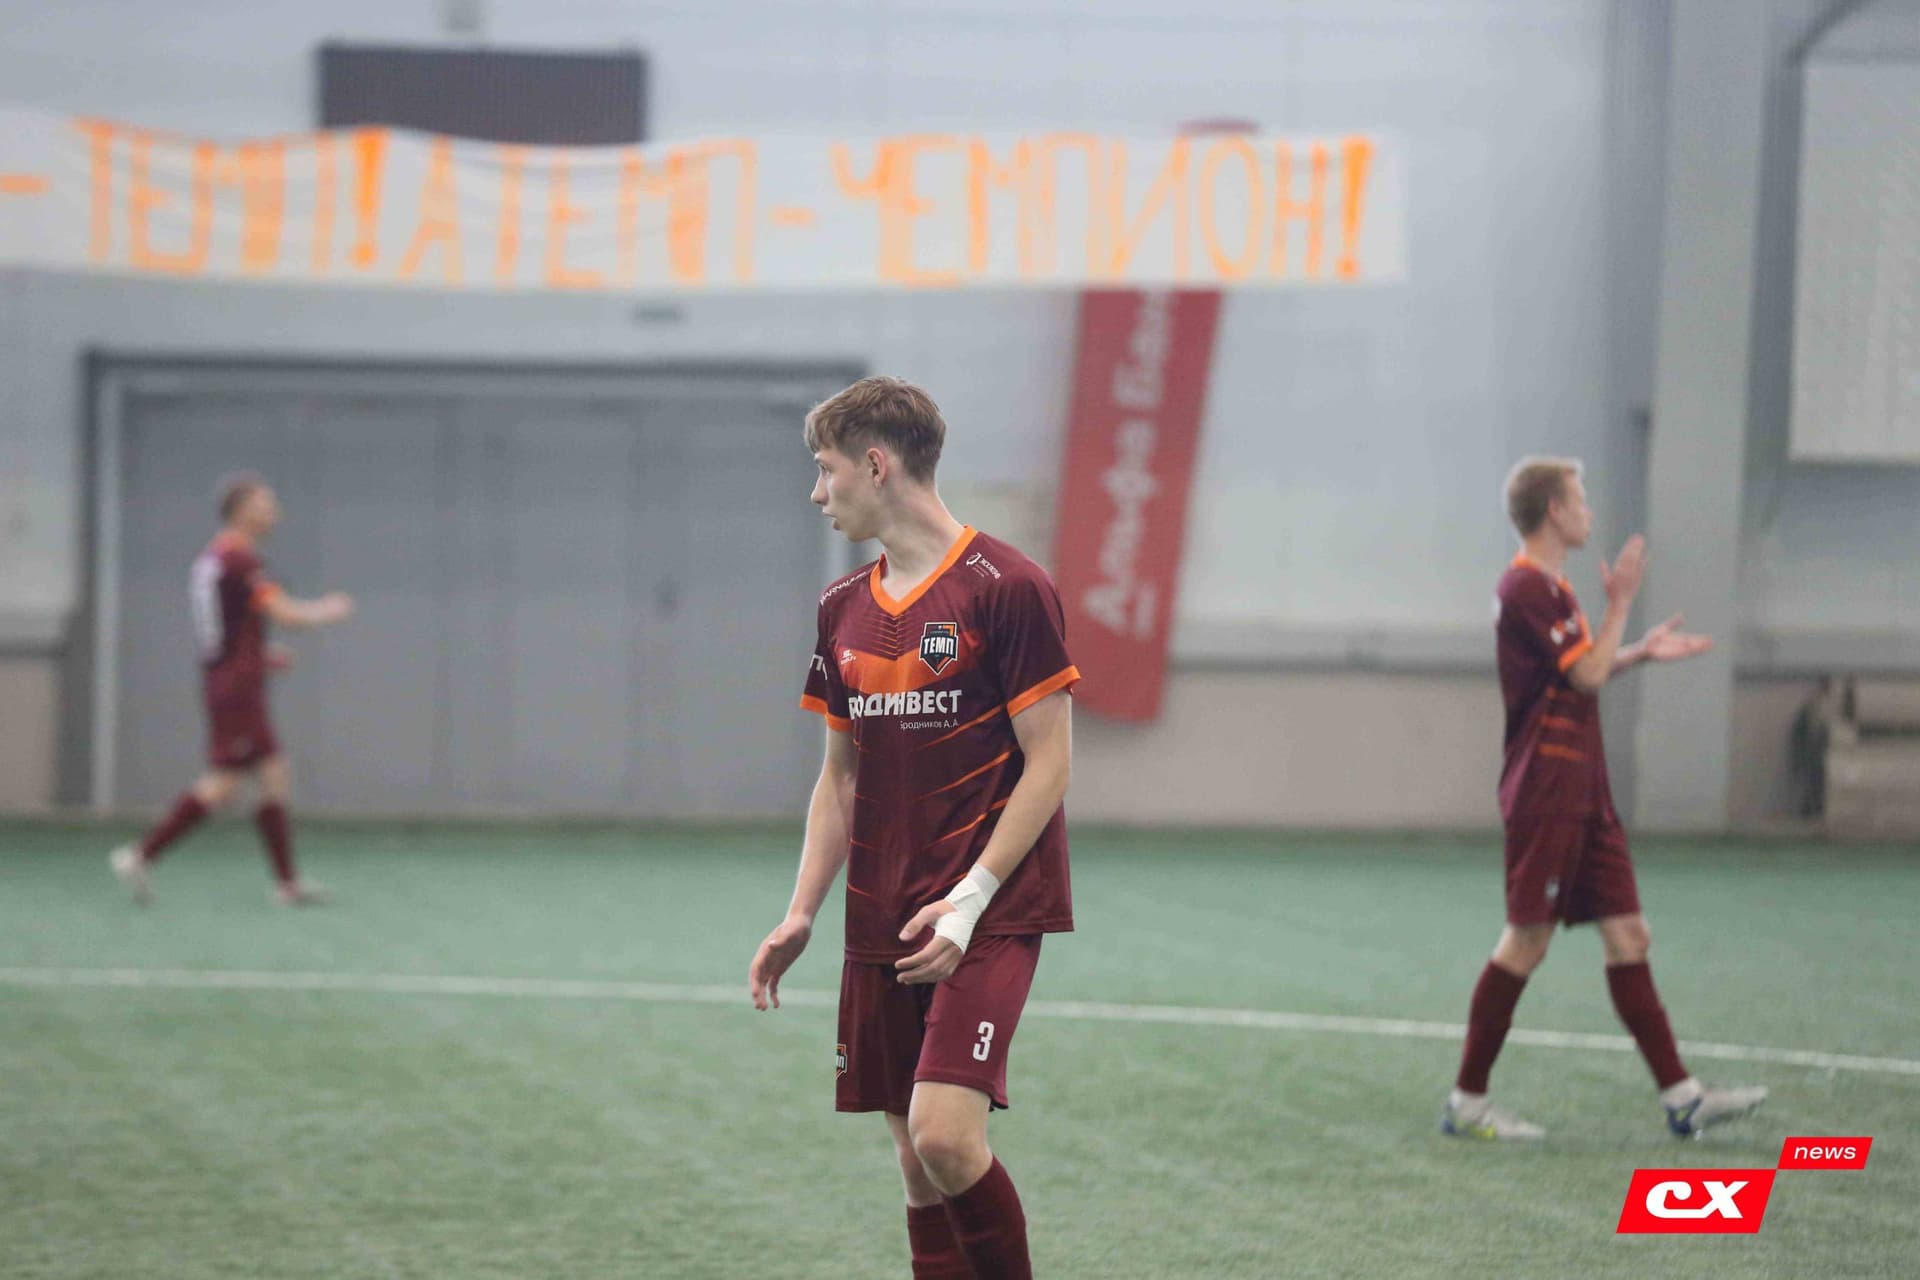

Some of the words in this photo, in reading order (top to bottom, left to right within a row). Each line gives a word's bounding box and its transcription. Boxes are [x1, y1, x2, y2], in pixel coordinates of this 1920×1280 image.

[832, 132, 1376, 289] ЧЕМПИОН!
[923, 636, 954, 655] ТЕМП
[973, 1021, 995, 1062] 3
